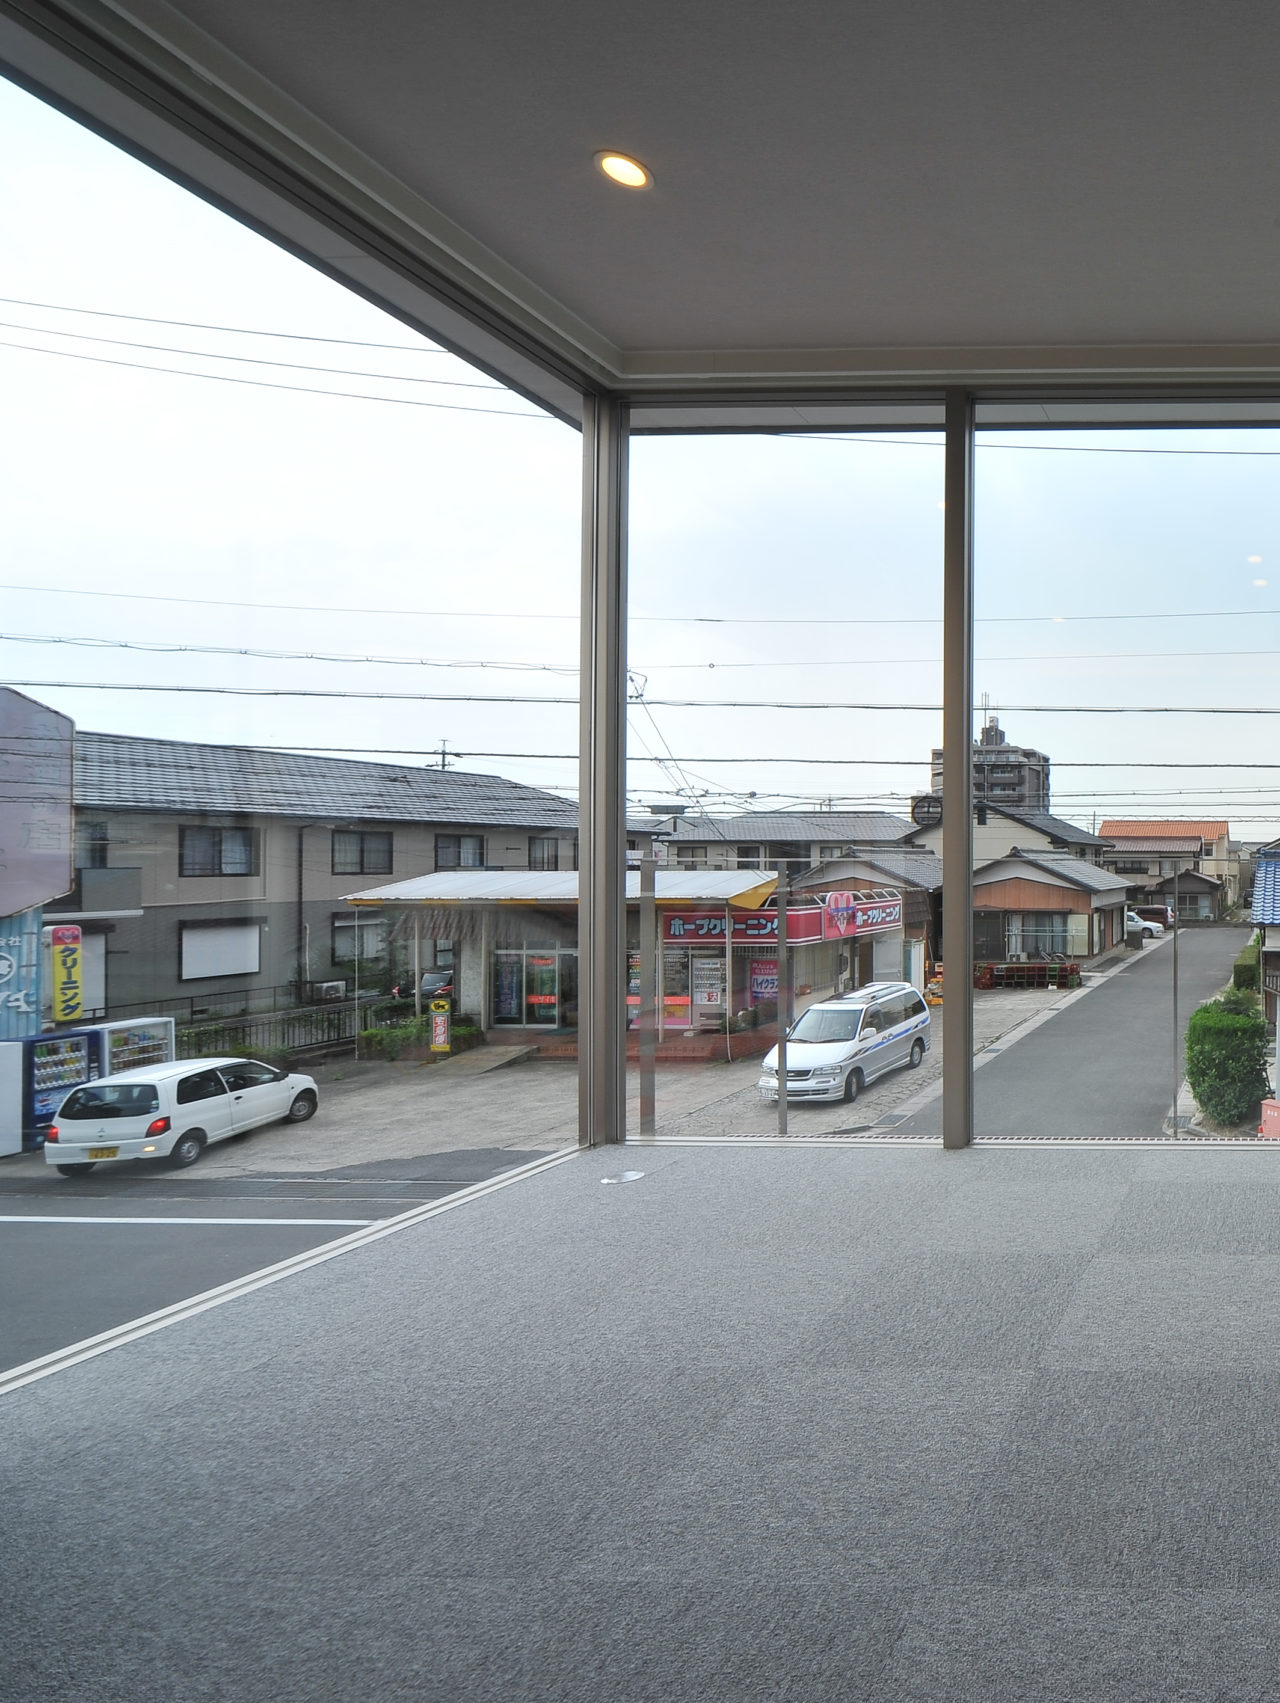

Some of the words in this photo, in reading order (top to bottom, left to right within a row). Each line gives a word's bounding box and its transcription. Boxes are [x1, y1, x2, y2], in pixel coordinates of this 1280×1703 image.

[856, 905, 900, 926] ホープクリーニング
[60, 946, 81, 1016] クリーニング
